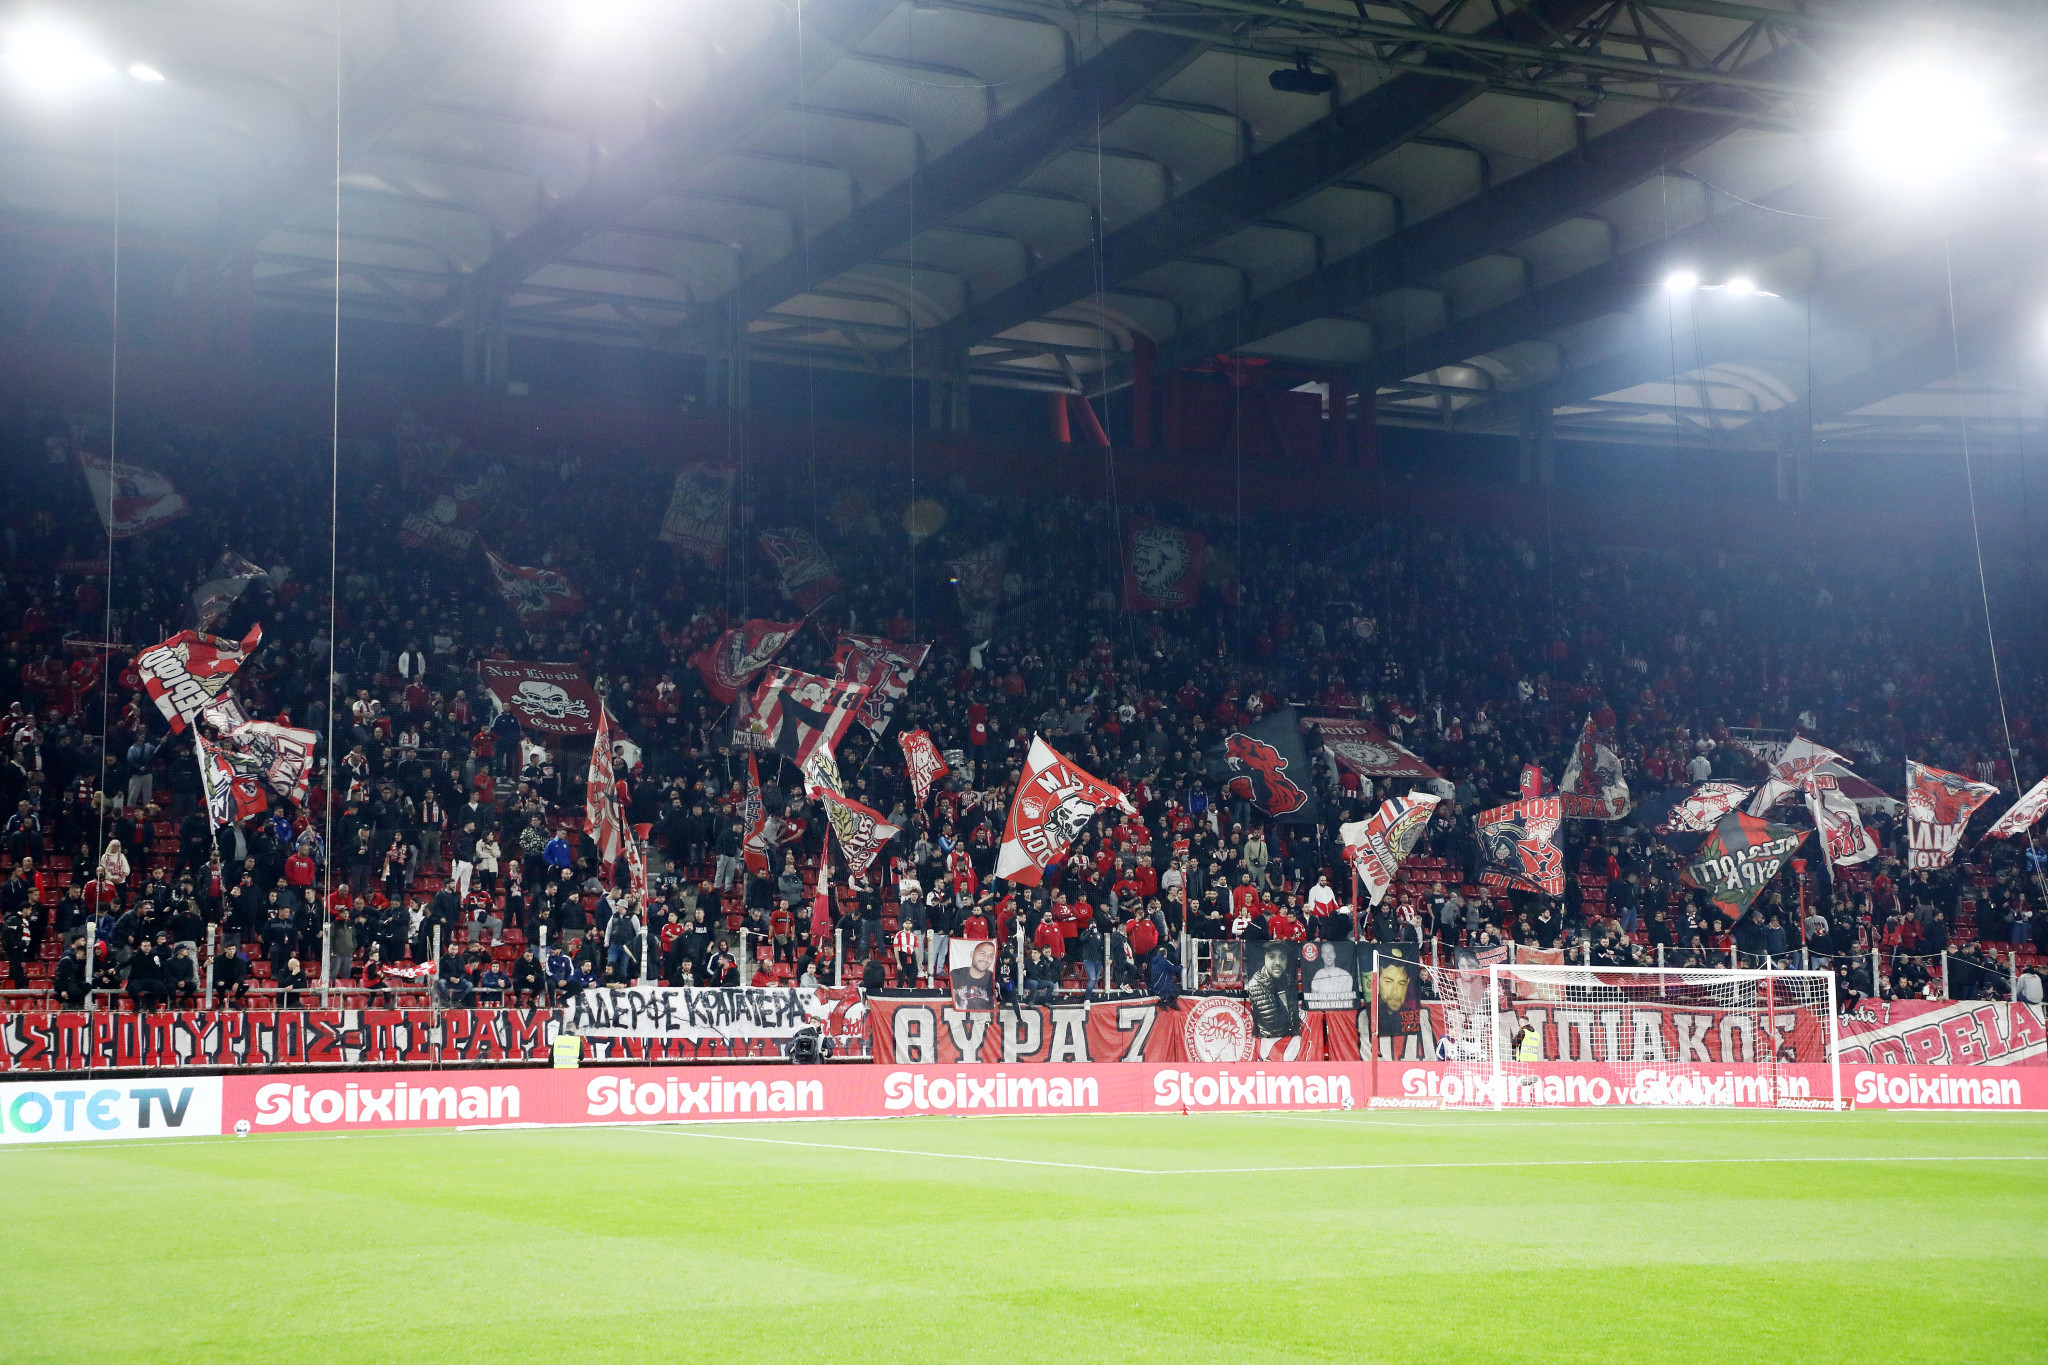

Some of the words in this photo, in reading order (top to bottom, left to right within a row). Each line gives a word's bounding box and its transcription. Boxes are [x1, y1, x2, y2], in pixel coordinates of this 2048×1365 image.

[893, 1004, 1093, 1063] ΘΥΡΑ
[1117, 1003, 1157, 1063] 7
[1880, 1002, 1892, 1025] 7
[255, 1082, 520, 1126] Stoiximan
[587, 1075, 824, 1117] Stoiximan
[884, 1071, 1099, 1110] Stoiximan
[1153, 1069, 1351, 1106] Stoiximan
[1401, 1068, 1588, 1104] Stoiximan
[1854, 1070, 2022, 1105] Stoiximan
[130, 1087, 194, 1129] TV
